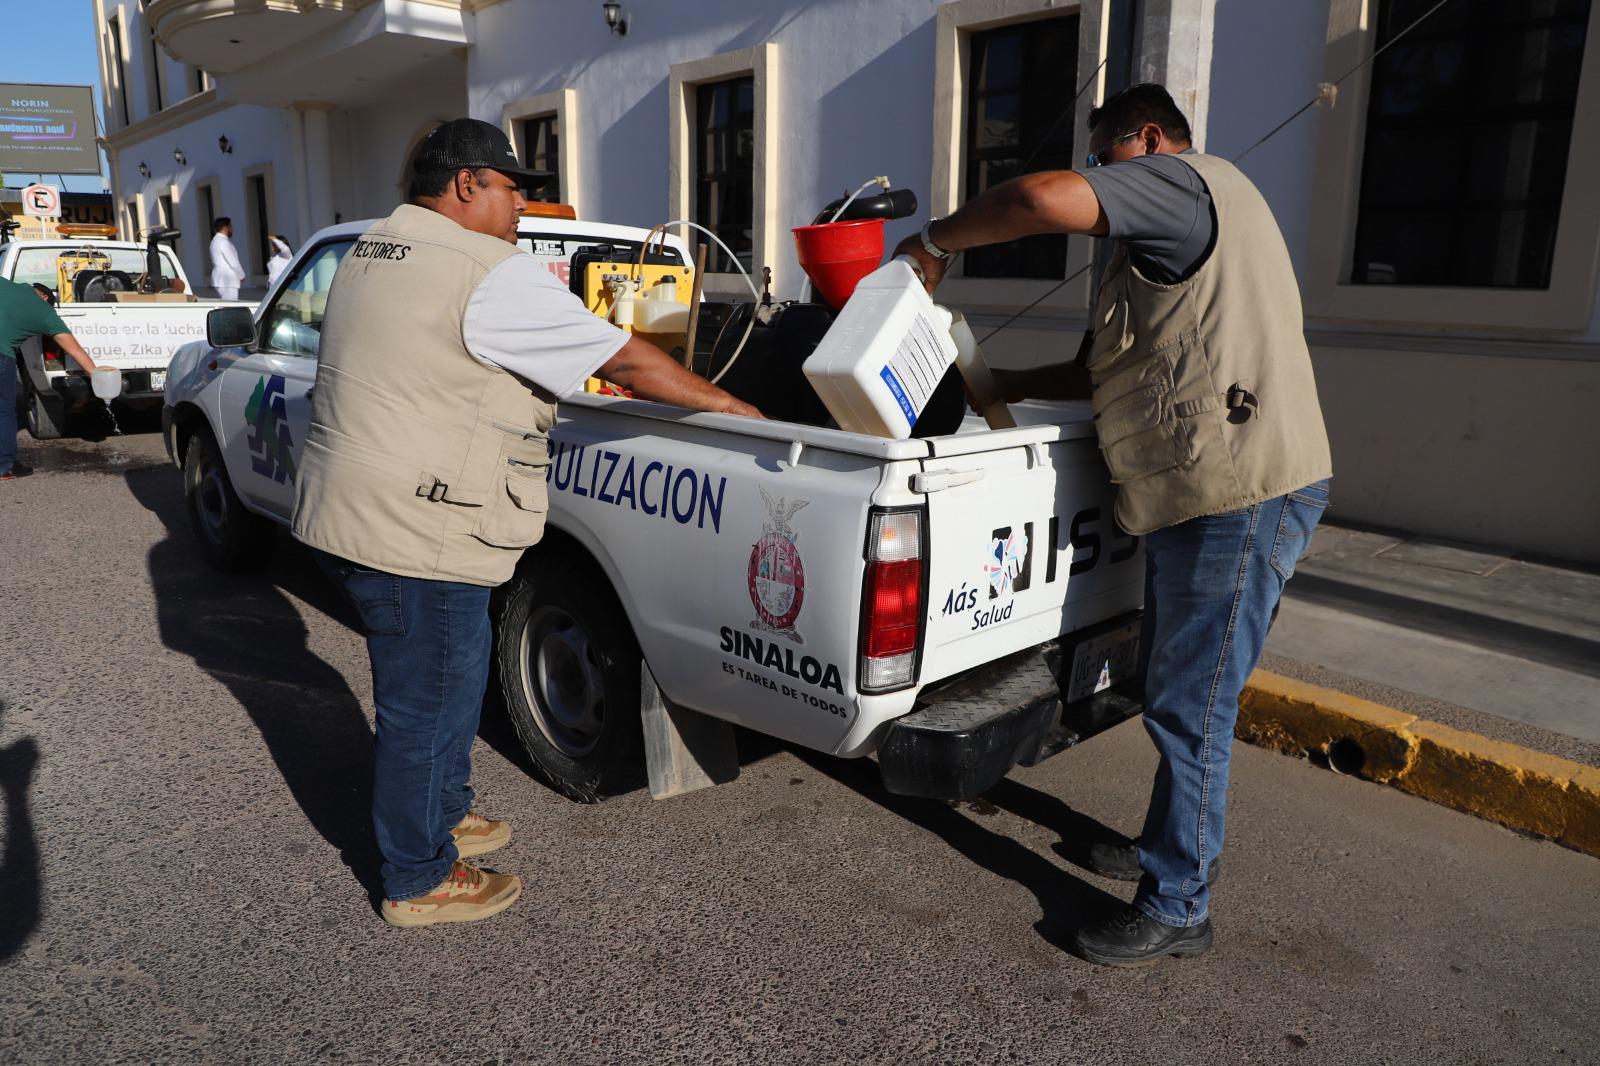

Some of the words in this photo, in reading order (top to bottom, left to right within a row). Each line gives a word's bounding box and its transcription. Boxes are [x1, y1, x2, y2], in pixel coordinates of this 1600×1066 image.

[11, 99, 49, 107] NORIN
[34, 191, 49, 209] E
[68, 322, 118, 335] inaloa
[147, 322, 160, 335] la
[130, 344, 162, 356] Zika
[167, 347, 176, 358] y
[971, 599, 1014, 631] Salud
[720, 626, 844, 696] SINALOA
[722, 661, 735, 675] ES
[738, 667, 778, 693] TAREA
[781, 684, 798, 700] DE
[801, 692, 847, 719] TODOS
